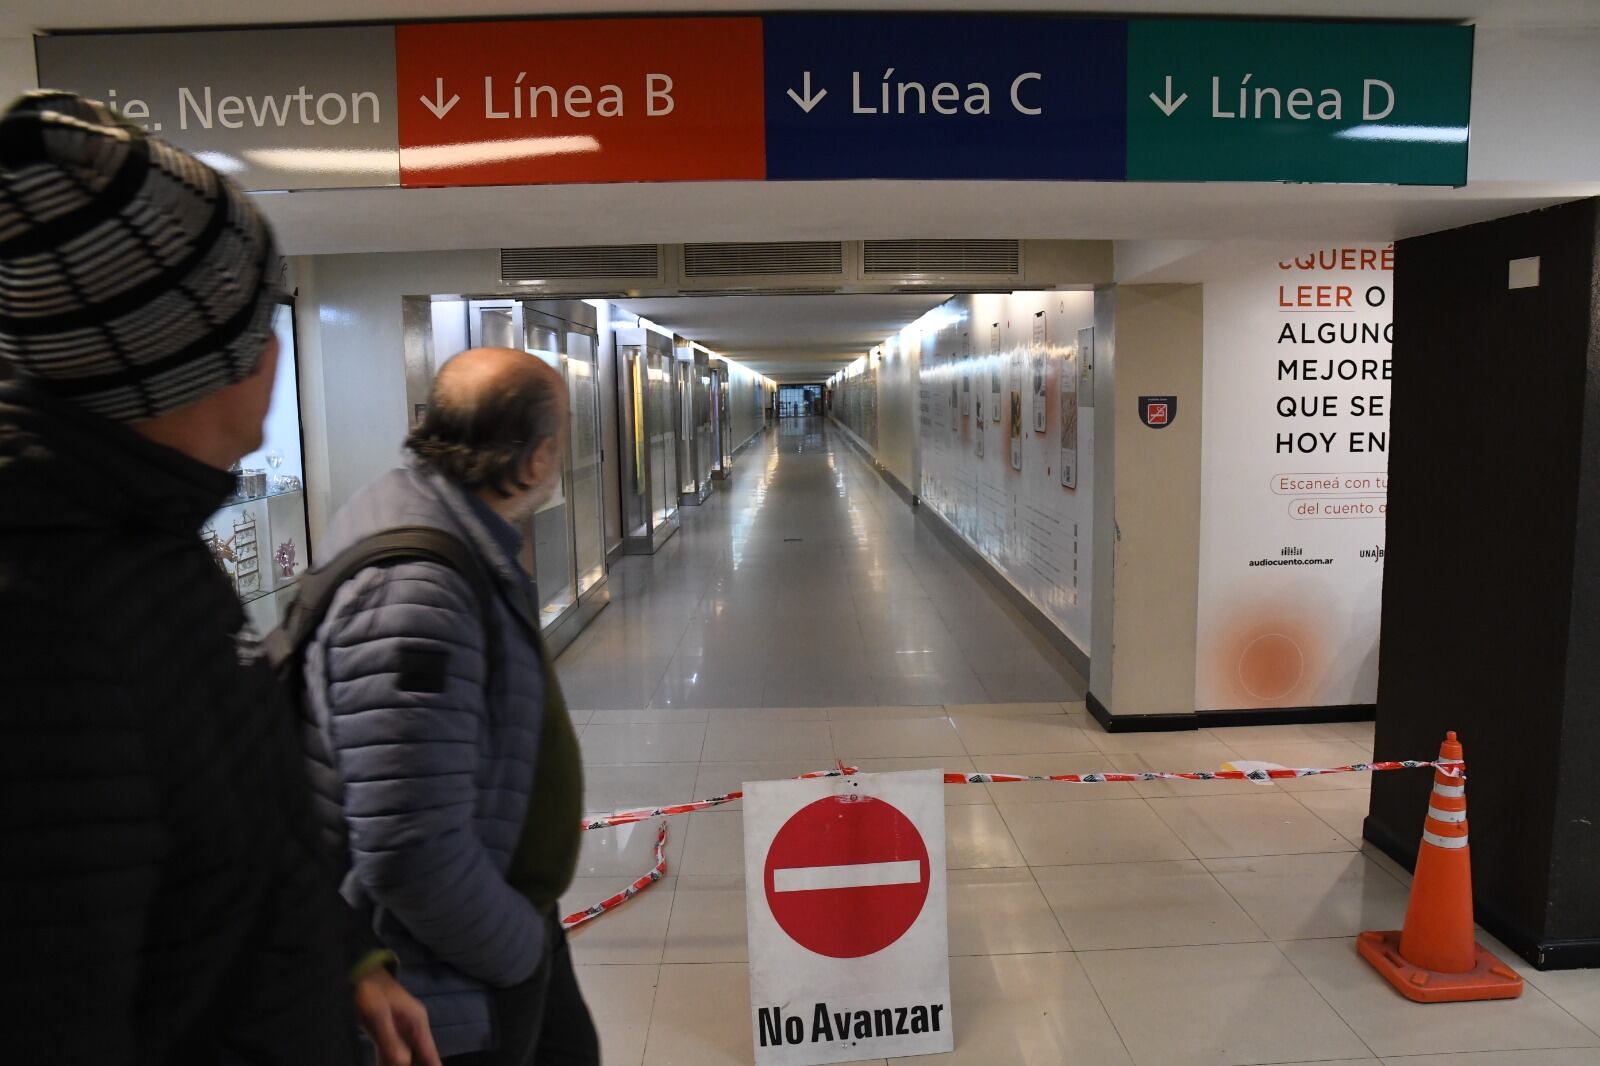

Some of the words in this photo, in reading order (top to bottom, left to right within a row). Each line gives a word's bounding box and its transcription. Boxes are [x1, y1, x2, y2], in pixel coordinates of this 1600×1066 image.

[485, 71, 624, 119] Línea
[646, 73, 675, 117] B
[852, 67, 991, 115] Línea
[1010, 71, 1042, 116] C
[1212, 73, 1342, 121] Línea
[1362, 78, 1395, 121] D
[178, 86, 380, 131] Newton
[1279, 285, 1353, 307] LEER
[1365, 285, 1386, 308] O
[1277, 359, 1392, 381] MEJORE
[1276, 395, 1338, 418] QUE
[1350, 395, 1384, 417] SE
[1276, 432, 1337, 454] HOY
[1349, 431, 1386, 453] EN
[1280, 476, 1340, 490] Escaneá
[1344, 480, 1371, 489] con
[1297, 502, 1319, 515] del
[1324, 502, 1374, 514] cuento
[1248, 557, 1334, 567] audiocuento.com.ar
[758, 1006, 804, 1047] No
[811, 1002, 944, 1043] Avanzar
